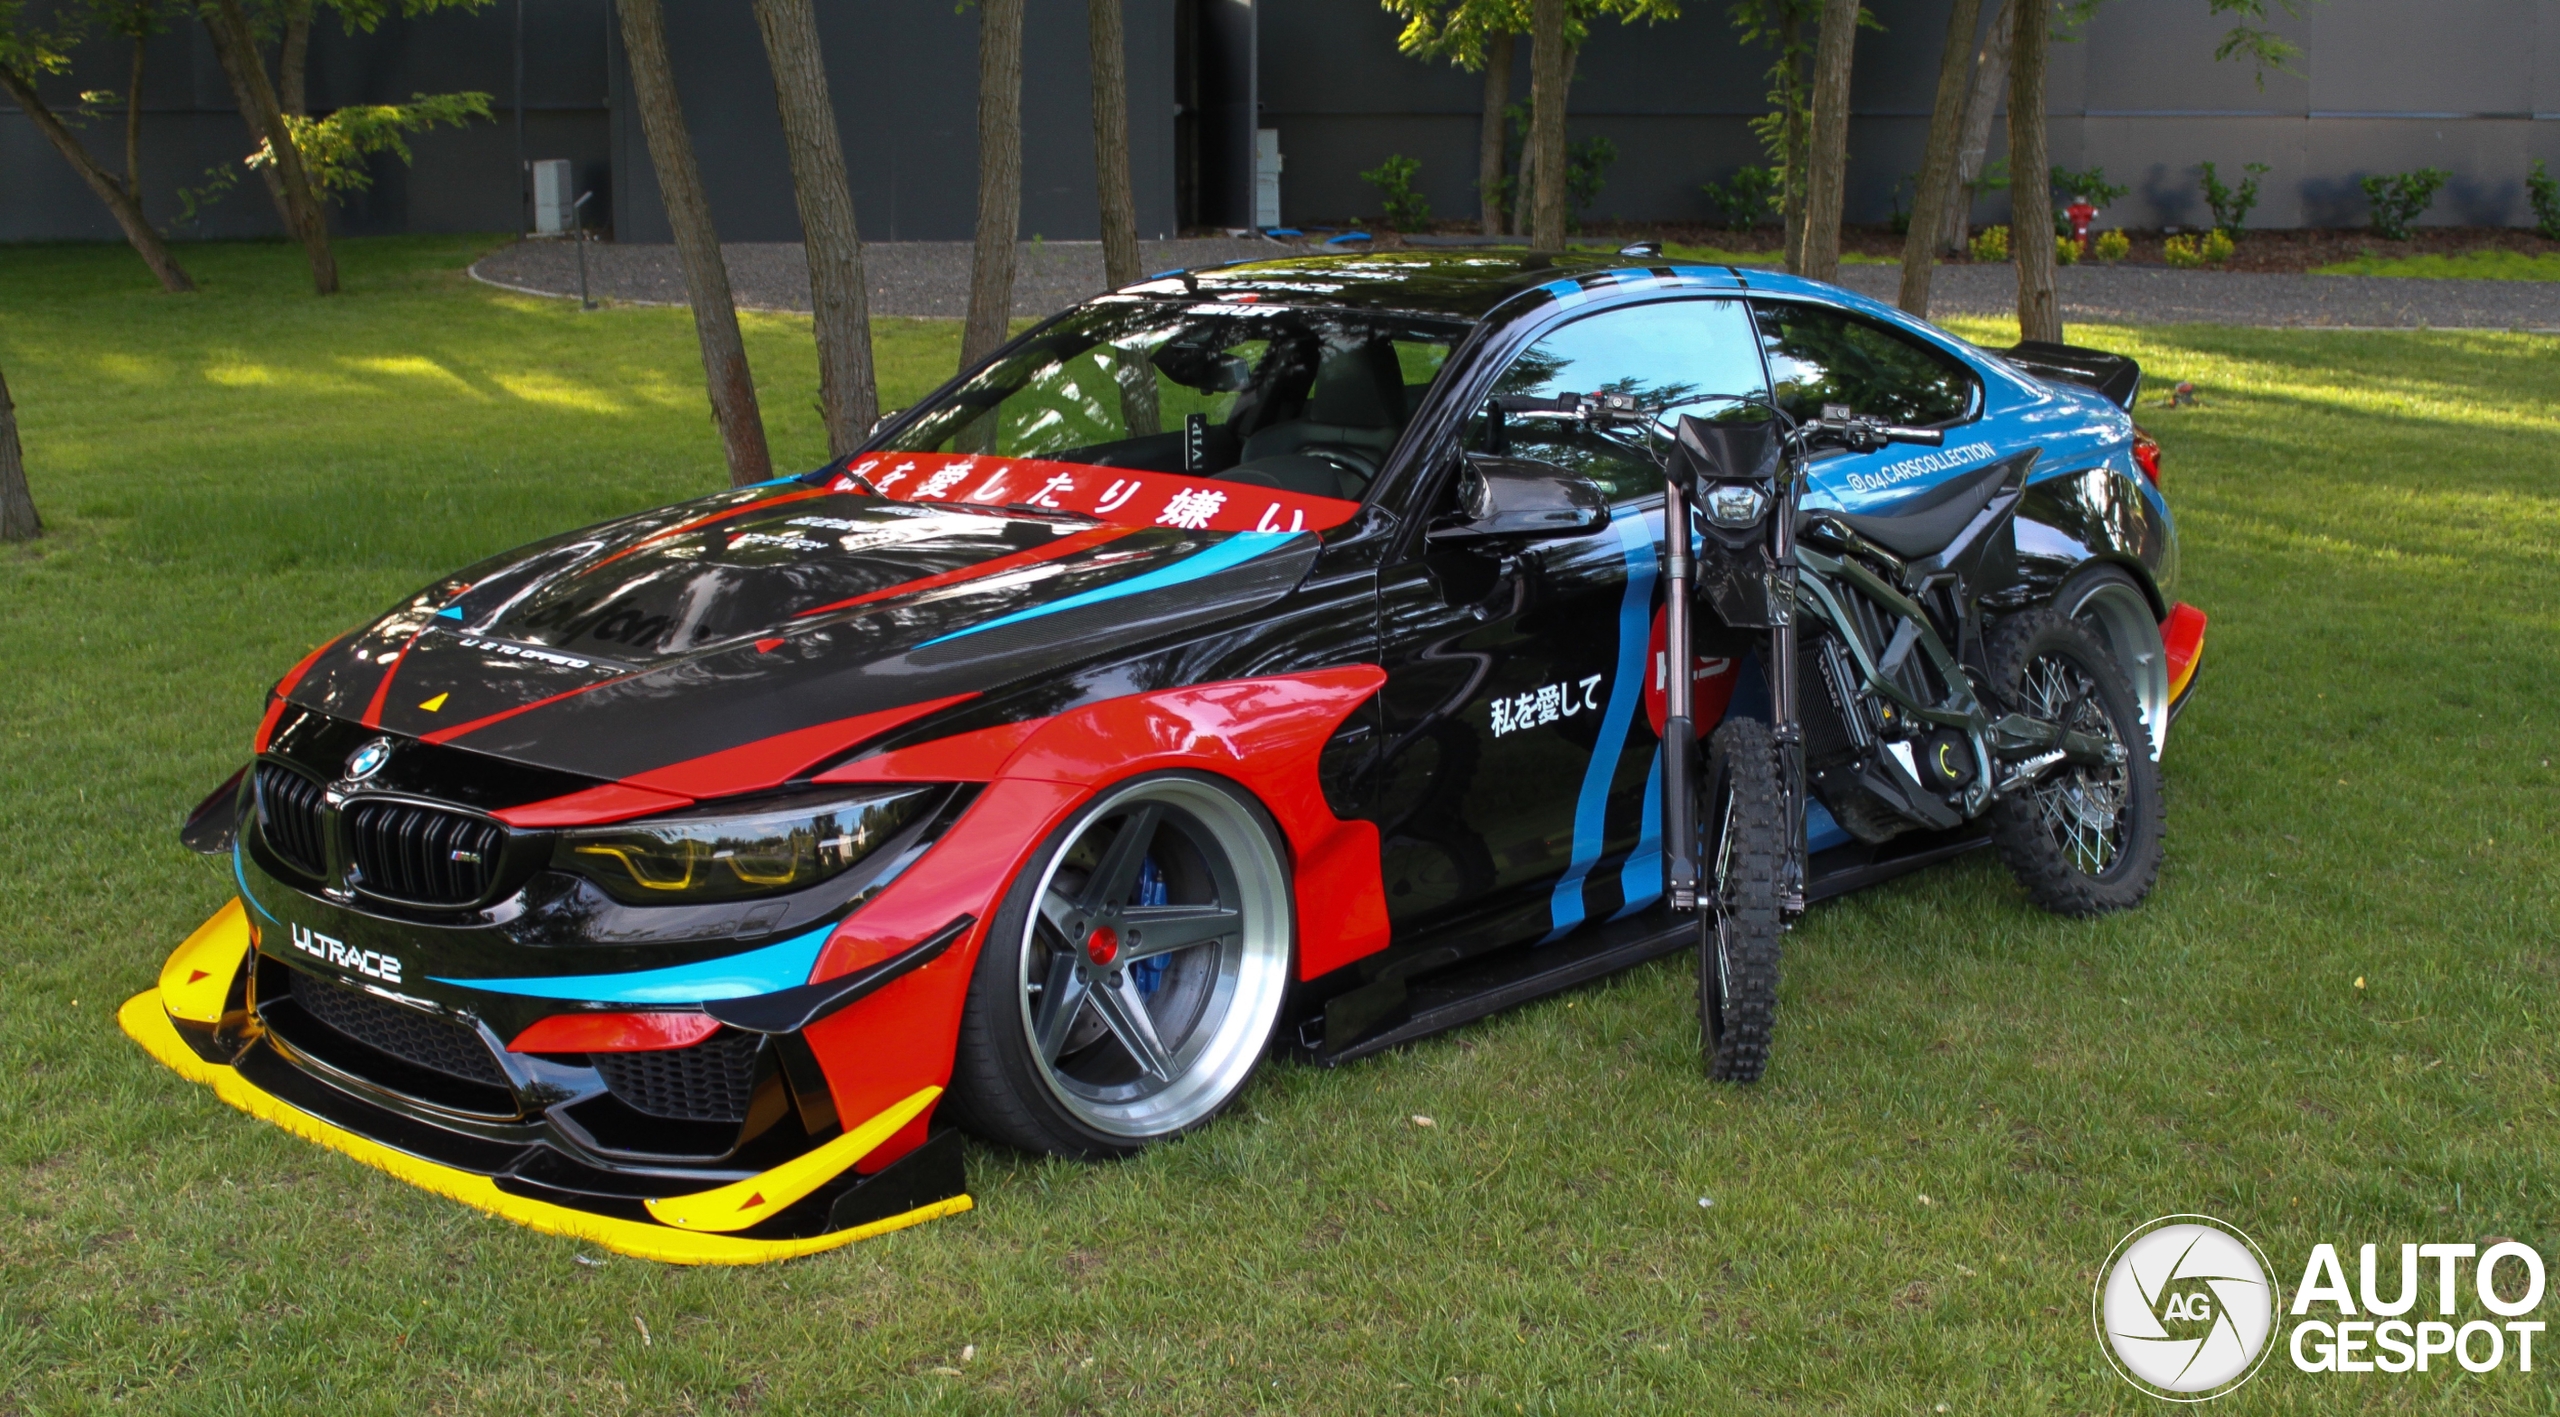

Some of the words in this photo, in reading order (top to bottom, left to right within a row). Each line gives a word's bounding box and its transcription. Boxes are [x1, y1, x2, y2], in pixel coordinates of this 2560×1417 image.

[1490, 673, 1602, 738] 私を愛して
[291, 922, 402, 983] ULTRACE
